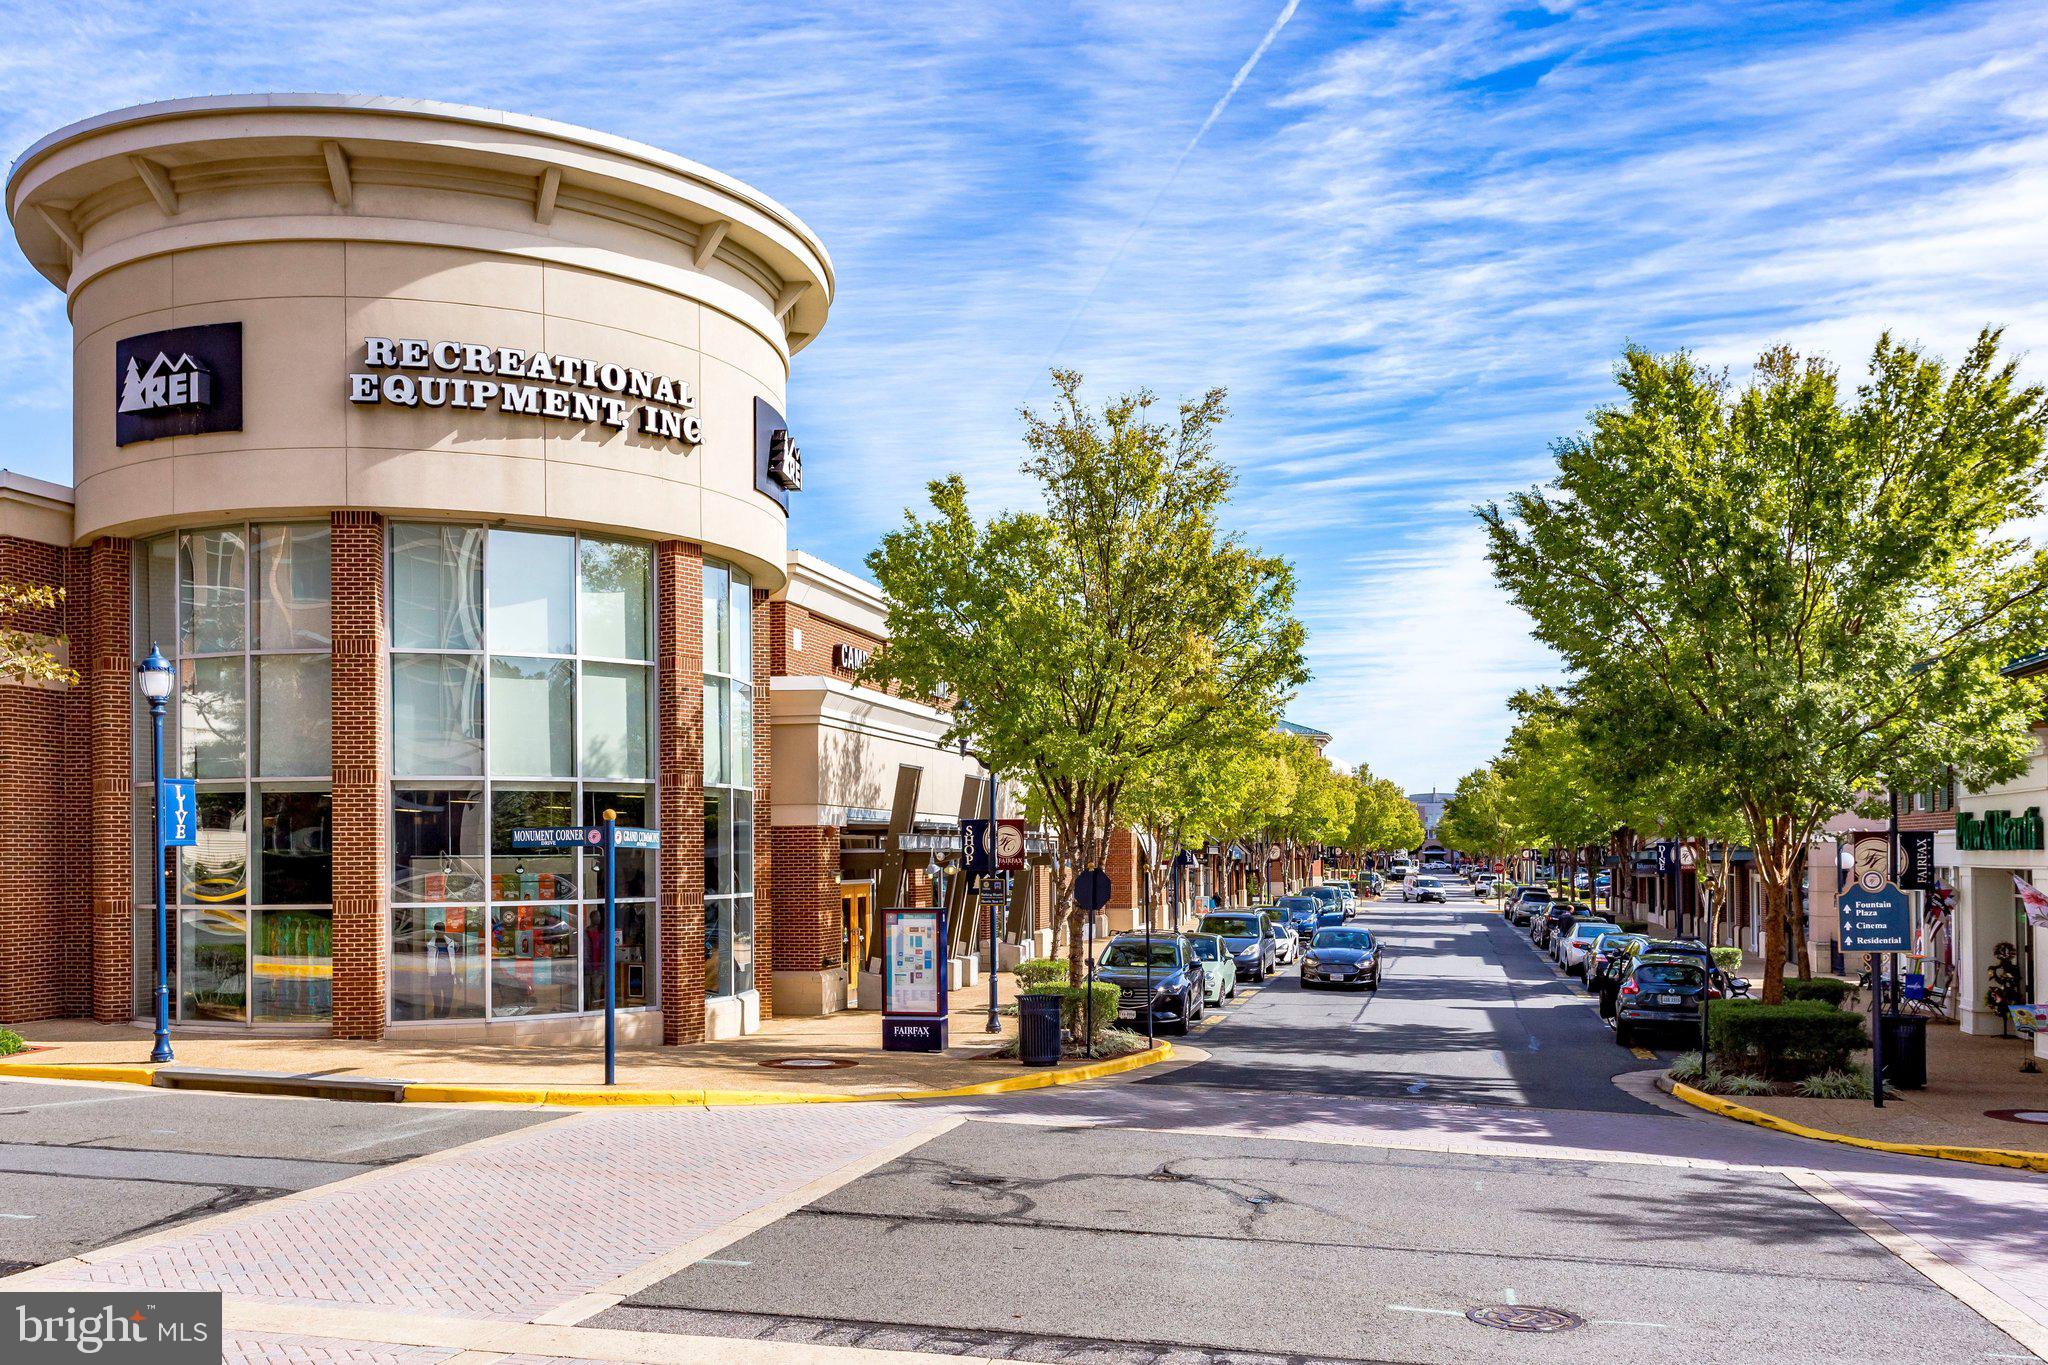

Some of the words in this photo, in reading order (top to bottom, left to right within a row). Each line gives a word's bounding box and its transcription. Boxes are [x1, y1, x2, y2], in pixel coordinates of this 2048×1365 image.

[146, 371, 199, 408] REI
[364, 336, 697, 410] RECREATIONAL
[349, 373, 630, 429] EQUIPMENT,
[645, 405, 706, 445] INC.
[175, 785, 188, 839] LIVE
[513, 829, 554, 842] MONUMENT
[555, 829, 584, 841] CORNER
[623, 830, 639, 842] GRAND
[964, 825, 974, 866] SHOP
[1658, 845, 1666, 870] DINE
[1917, 839, 1927, 884] FAIRFAX
[1857, 936, 1902, 944] Residential
[893, 1026, 930, 1035] FAIRFAX
